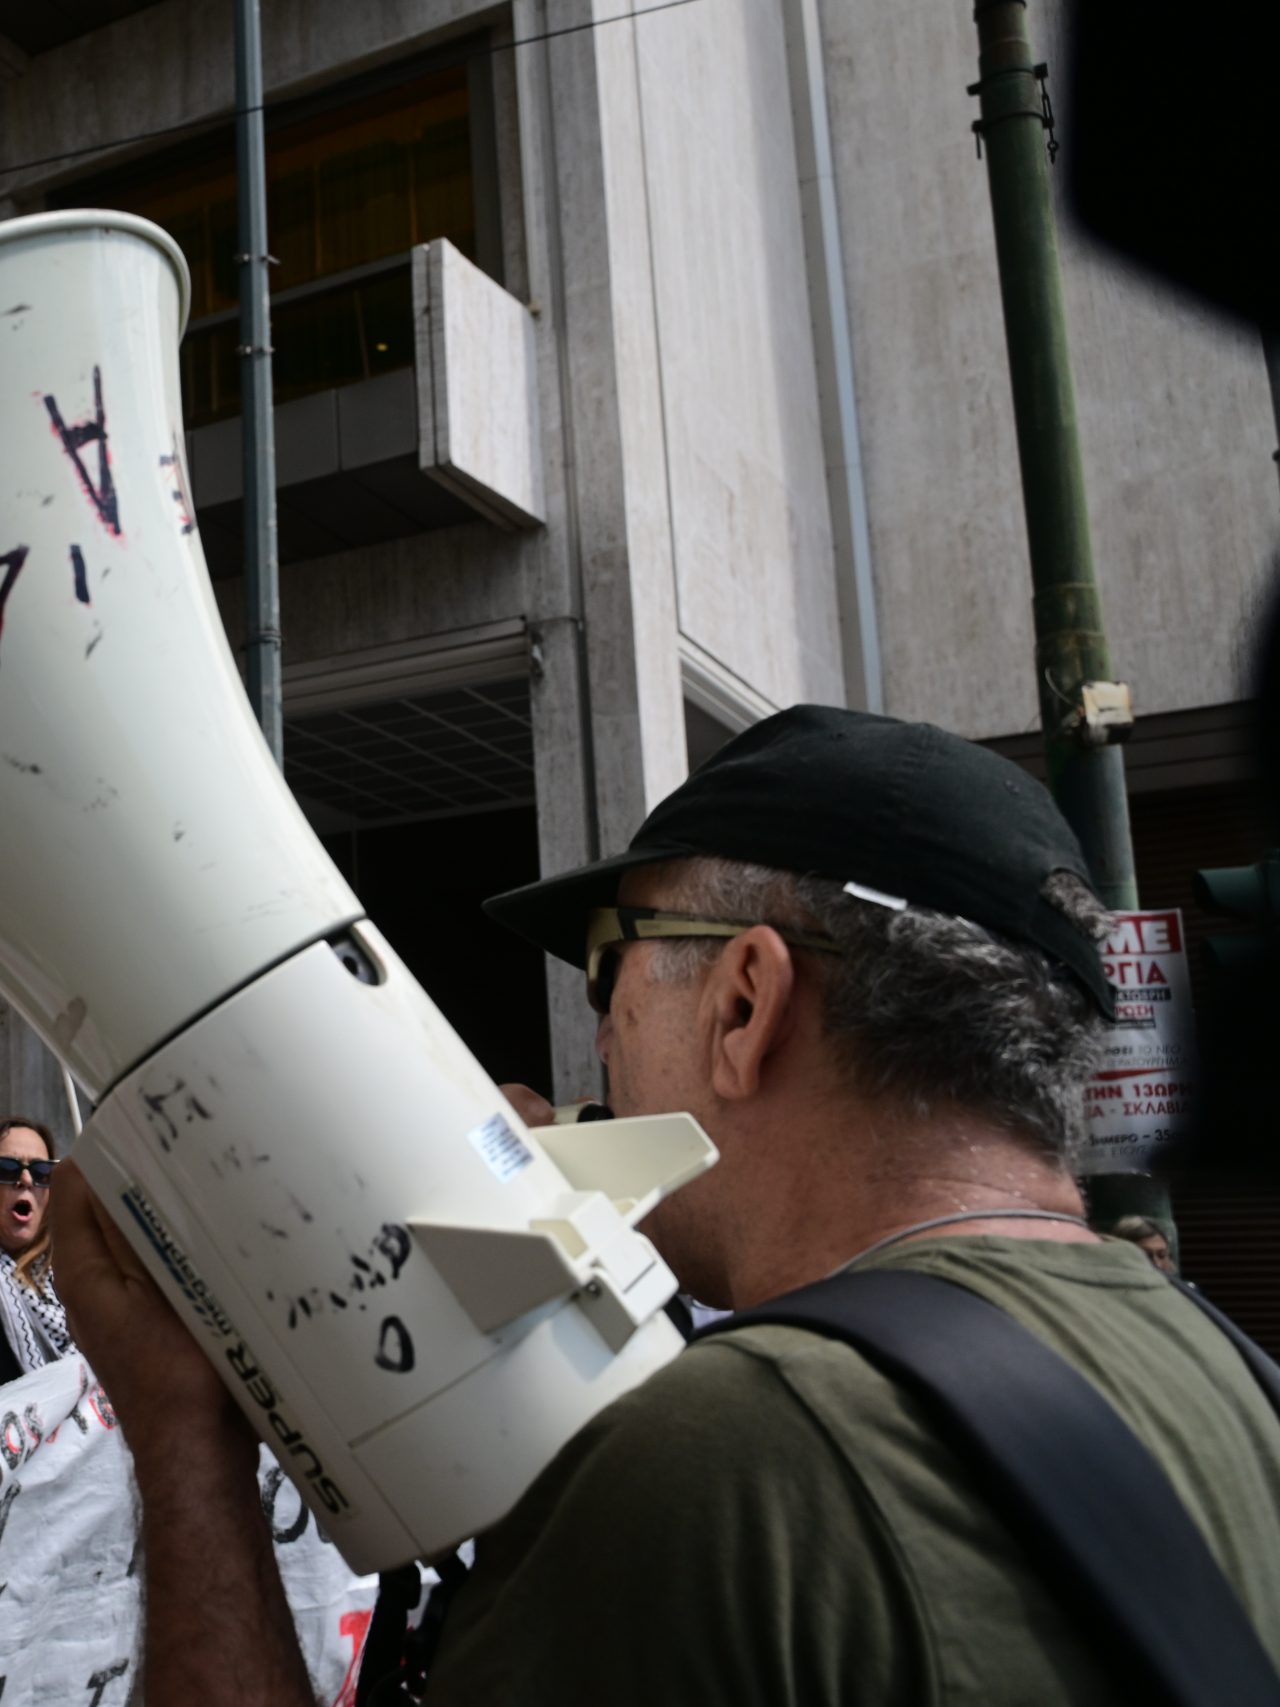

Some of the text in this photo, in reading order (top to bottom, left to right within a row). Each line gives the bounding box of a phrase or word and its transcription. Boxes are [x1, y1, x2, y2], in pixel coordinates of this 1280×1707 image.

[1104, 961, 1168, 985] ΡΓΙΑ
[128, 1184, 234, 1337] megaphone
[226, 1342, 349, 1515] SUPER
